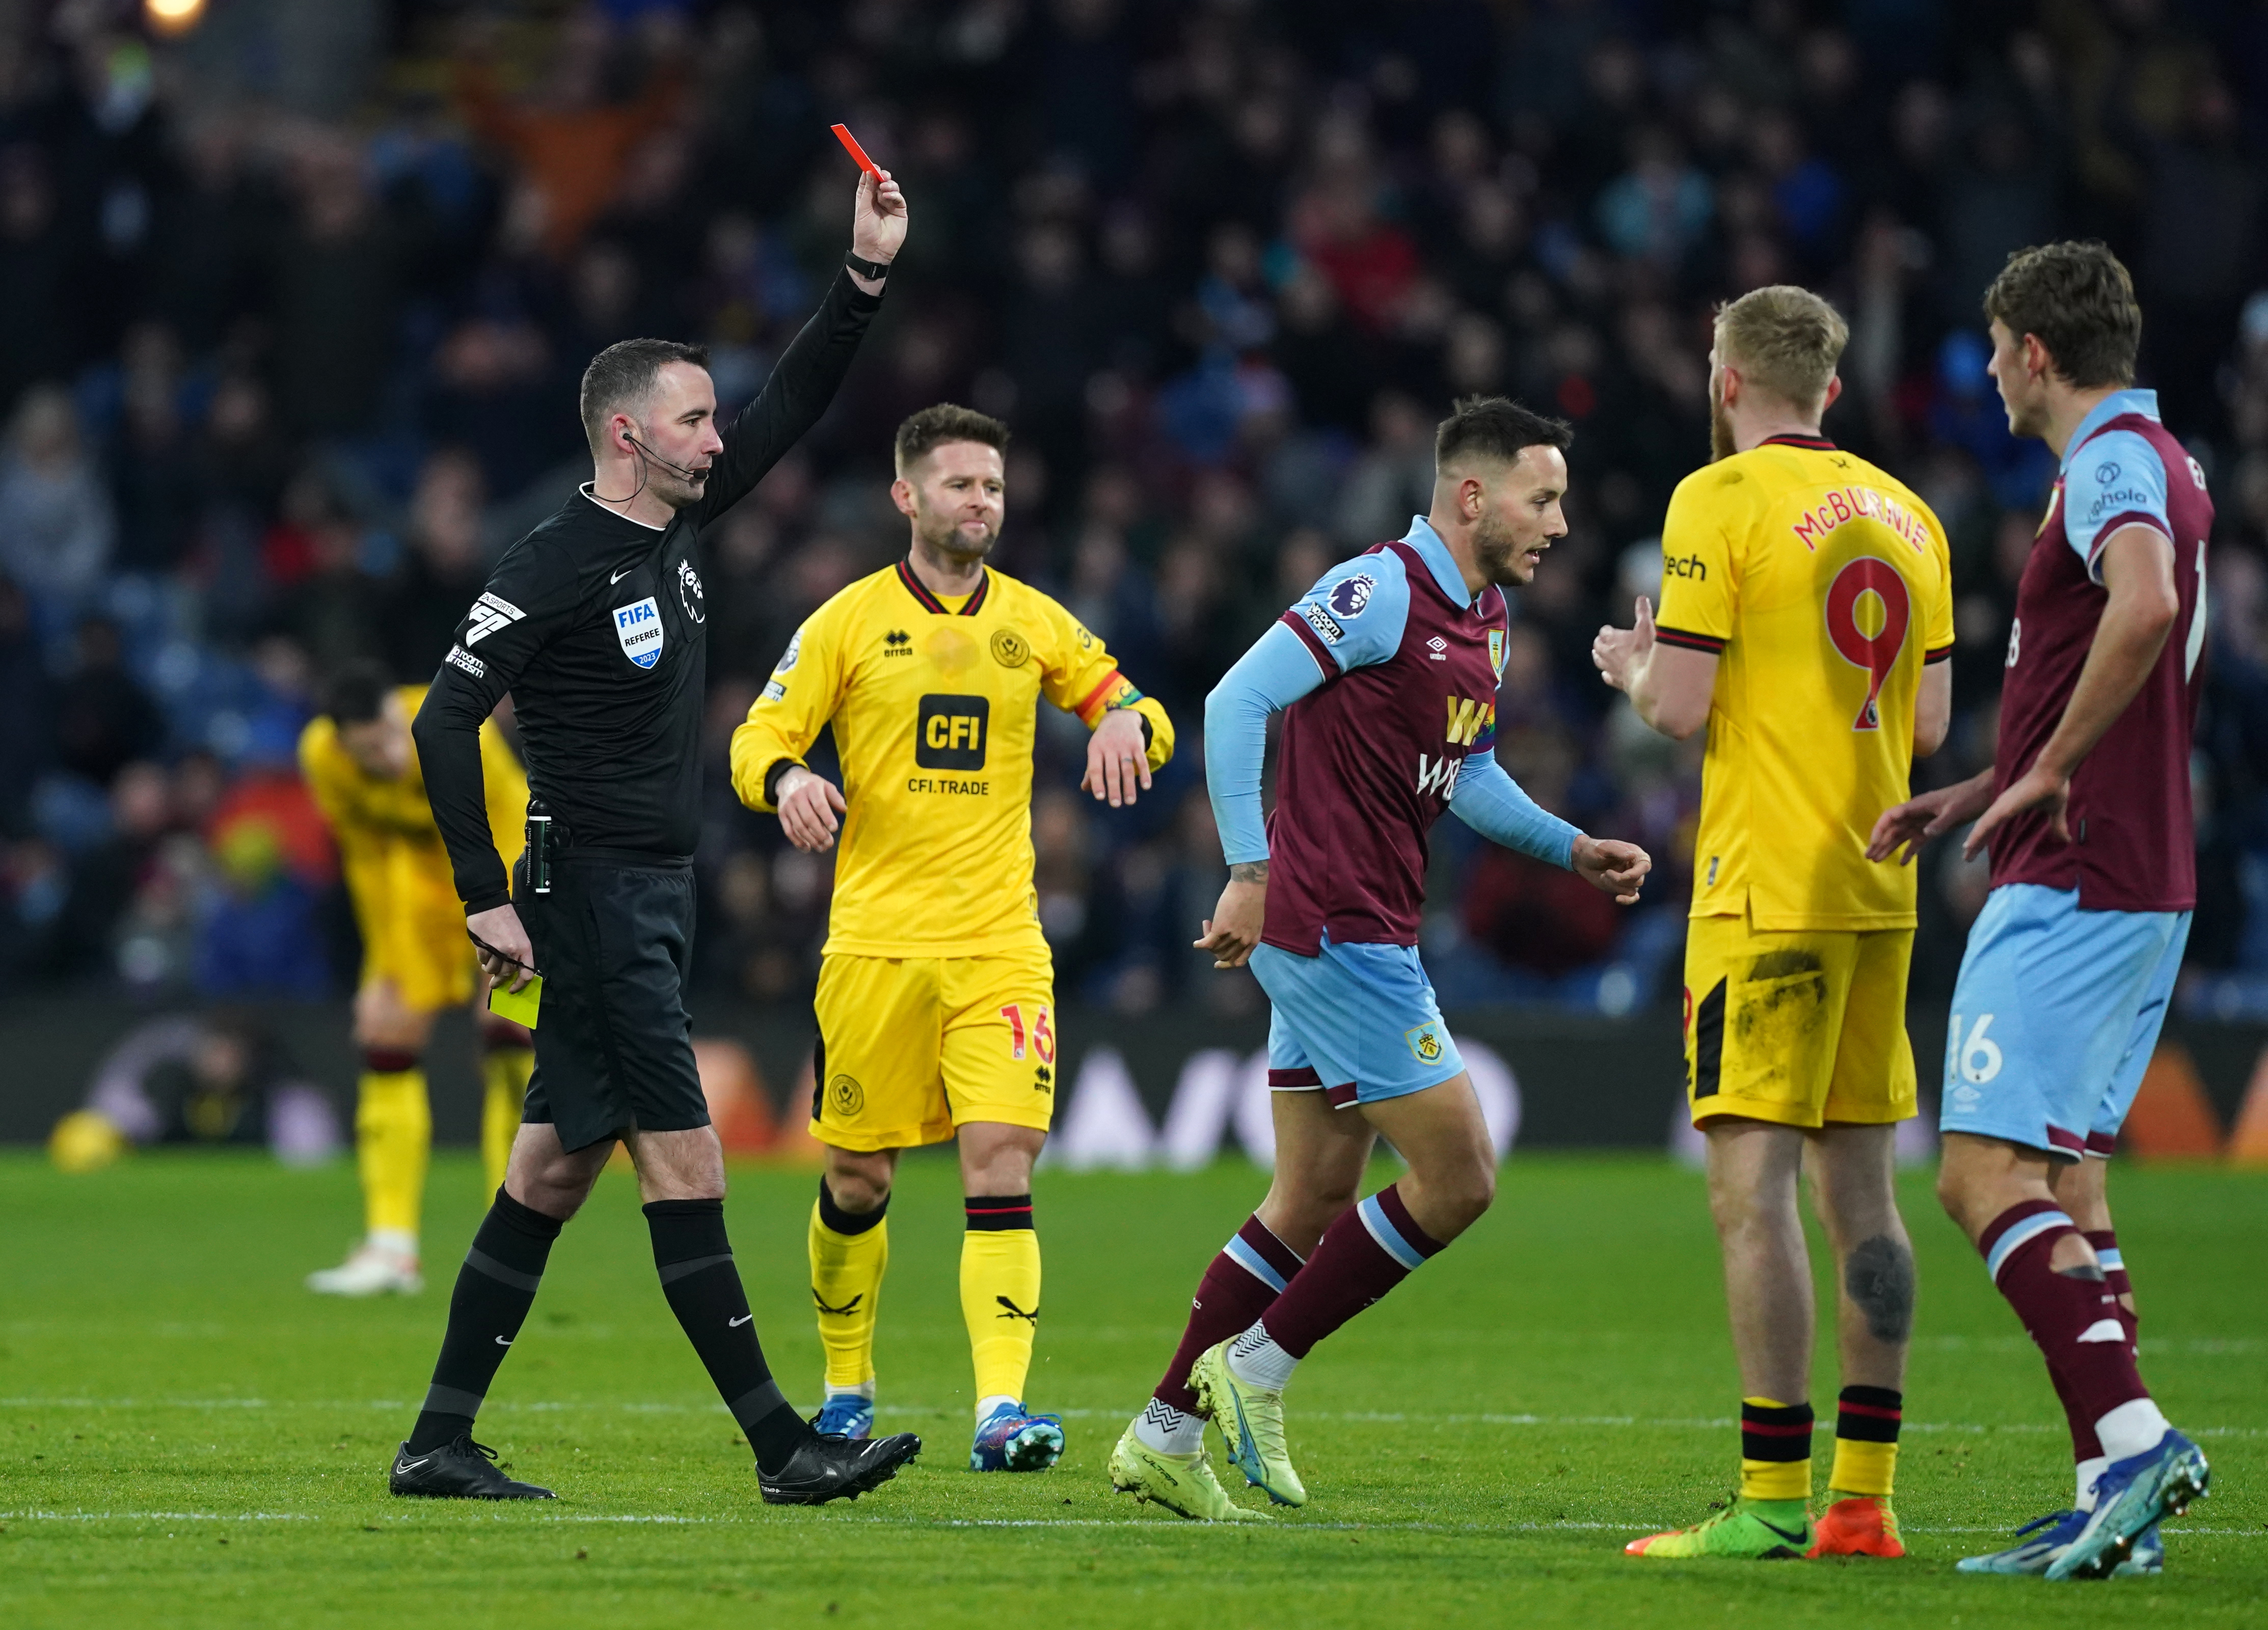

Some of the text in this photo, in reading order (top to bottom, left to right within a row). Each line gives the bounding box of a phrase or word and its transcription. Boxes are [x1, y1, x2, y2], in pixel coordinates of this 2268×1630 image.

[1664, 554, 1706, 581] ech
[489, 595, 516, 615] SPORTS
[618, 604, 655, 628] FIFA
[1316, 612, 1340, 636] room
[625, 628, 660, 647] REFEREE
[1825, 556, 1910, 732] 9
[453, 658, 484, 678] racism
[458, 650, 483, 668] room
[639, 653, 656, 664] 2023
[926, 714, 980, 751] CFI
[908, 778, 989, 795] CFI.TRADE
[1001, 1004, 1055, 1064] 16
[1949, 1013, 2003, 1084] 16
[1143, 1454, 1179, 1486] ULTRA
